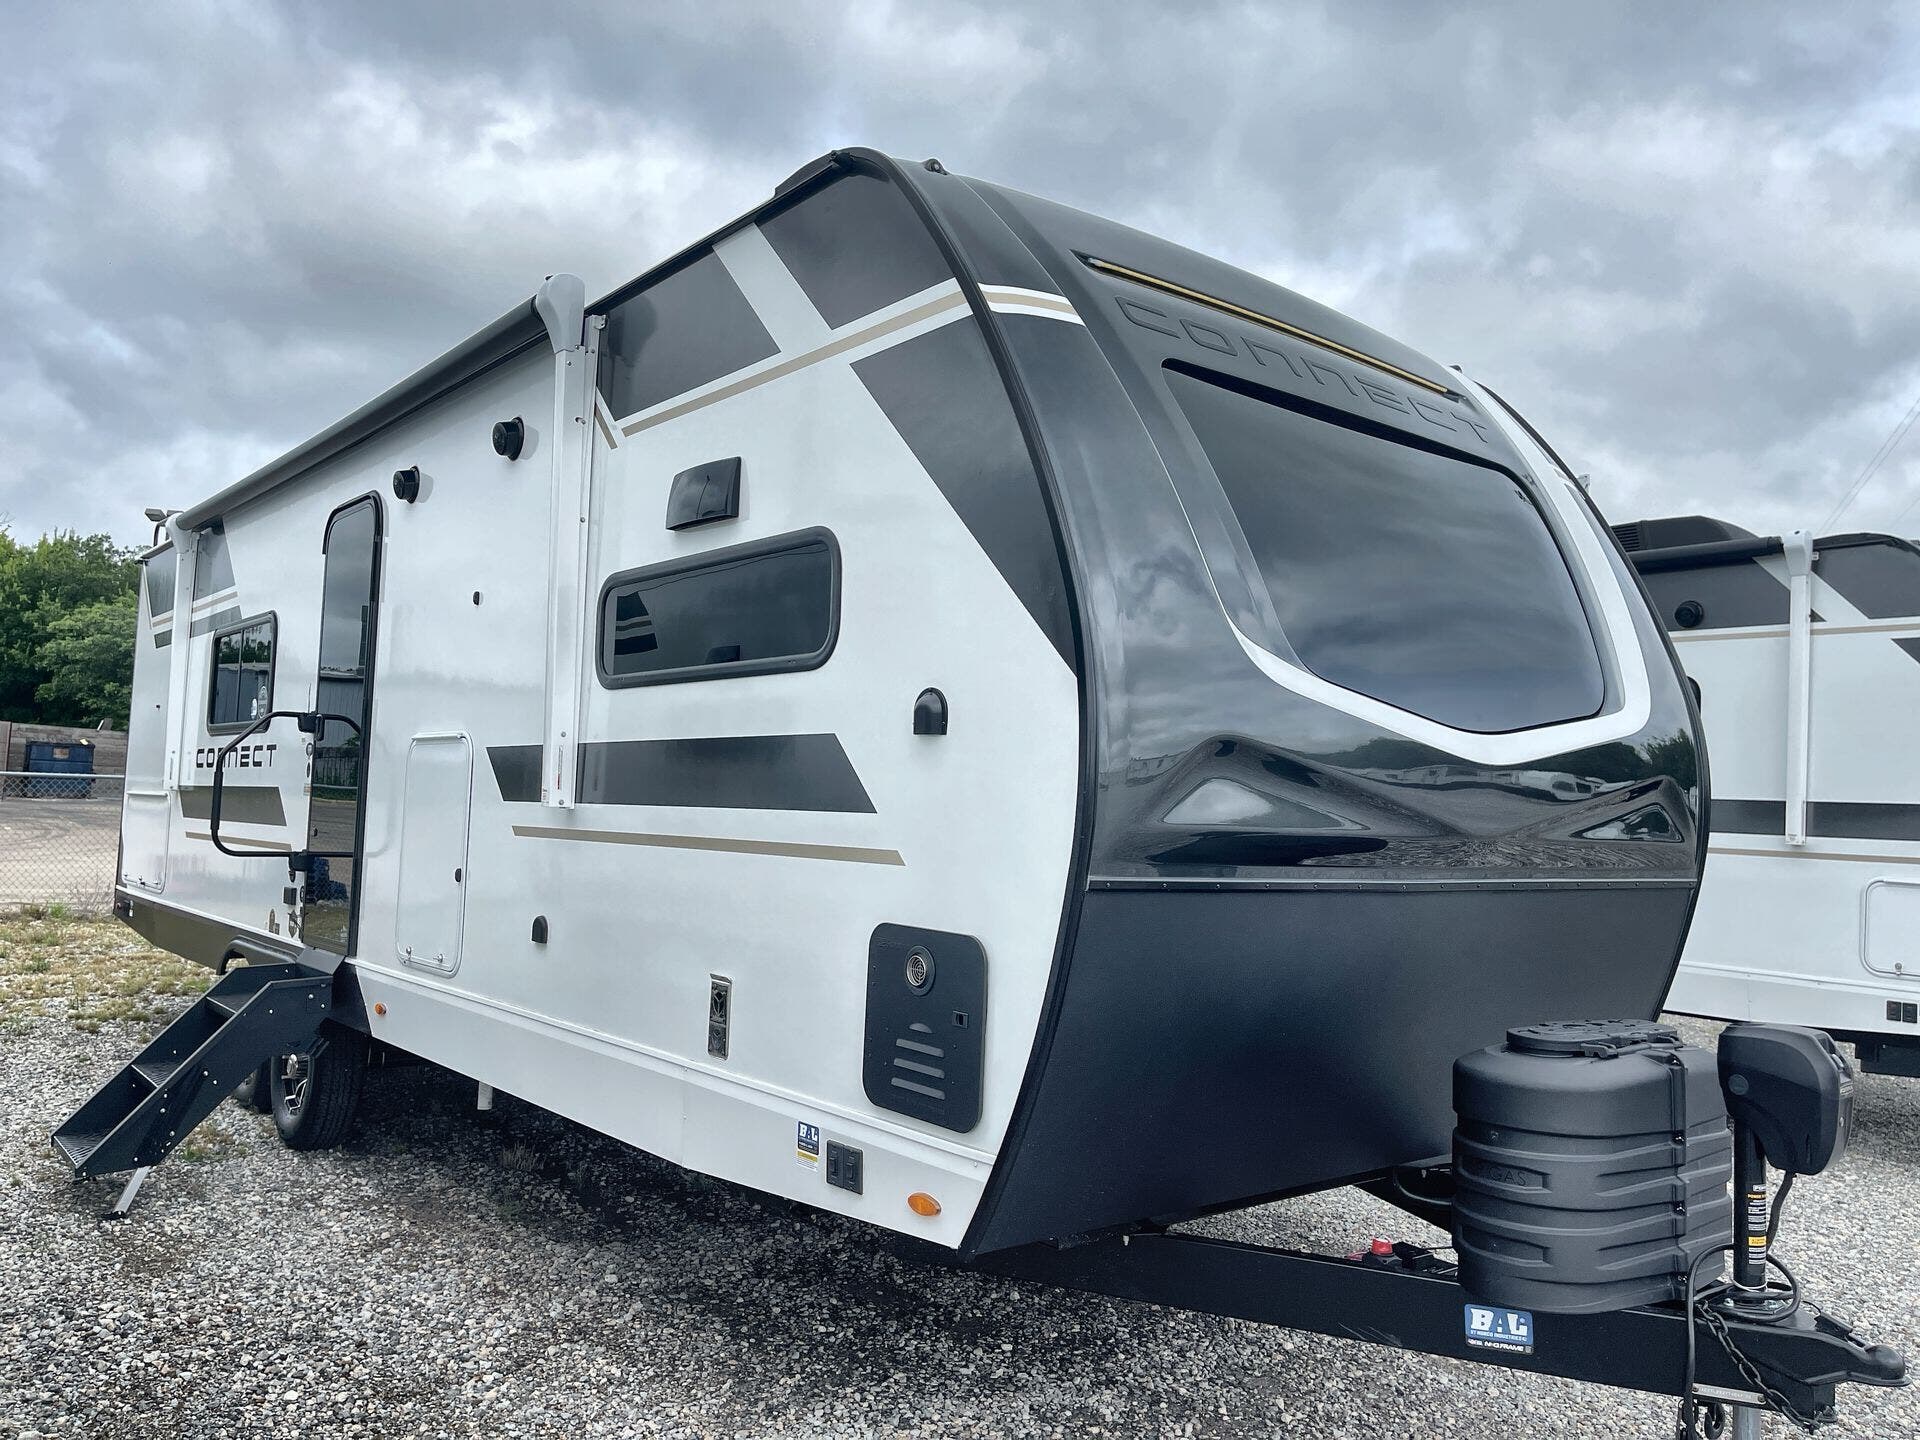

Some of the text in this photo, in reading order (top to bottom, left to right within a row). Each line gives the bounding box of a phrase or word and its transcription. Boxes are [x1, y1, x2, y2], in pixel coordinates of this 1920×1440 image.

[1115, 296, 1489, 444] CONNECT
[800, 1123, 818, 1141] BAL
[1470, 1308, 1528, 1336] BAL
